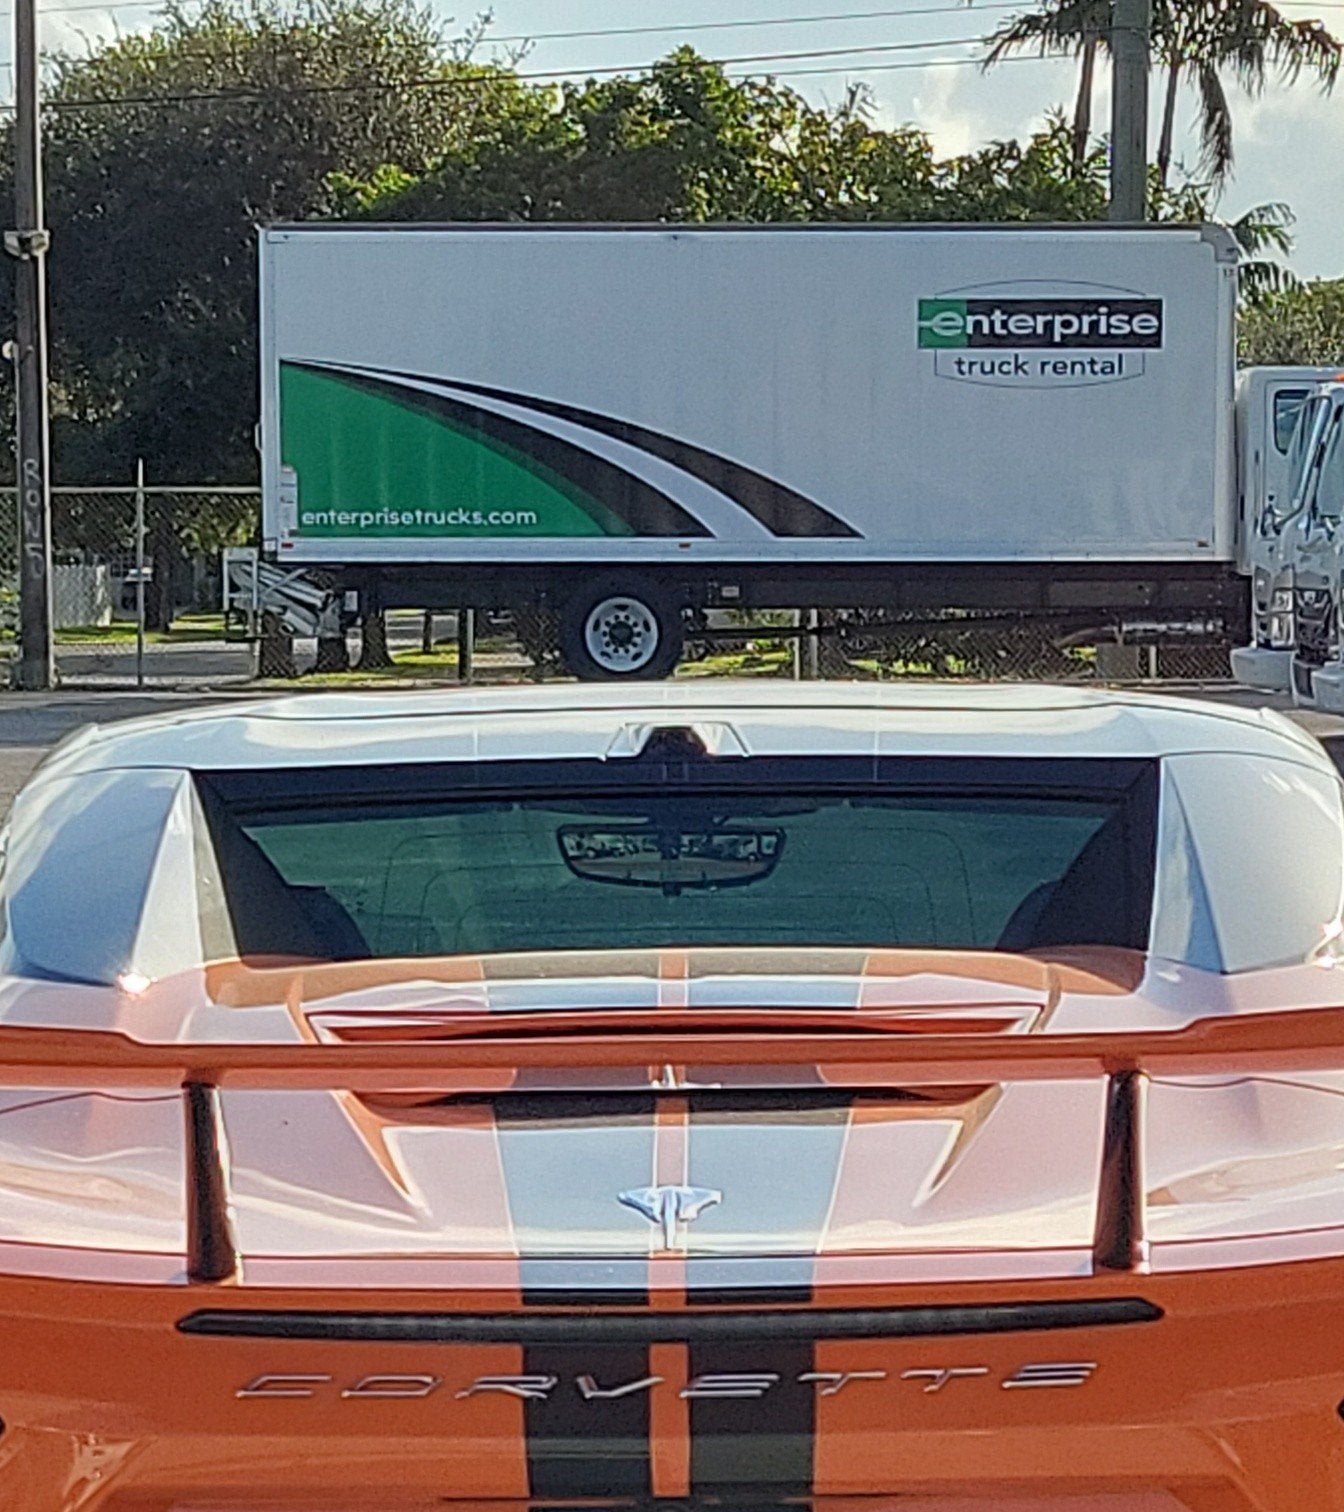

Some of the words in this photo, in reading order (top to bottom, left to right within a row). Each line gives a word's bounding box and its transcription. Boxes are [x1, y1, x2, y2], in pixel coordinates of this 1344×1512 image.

[918, 306, 1159, 342] enterprise
[954, 352, 1030, 376] truck
[1039, 352, 1124, 376] rental
[301, 507, 538, 527] enterprisetrucks.com
[234, 1361, 1098, 1400] CORVETTE
